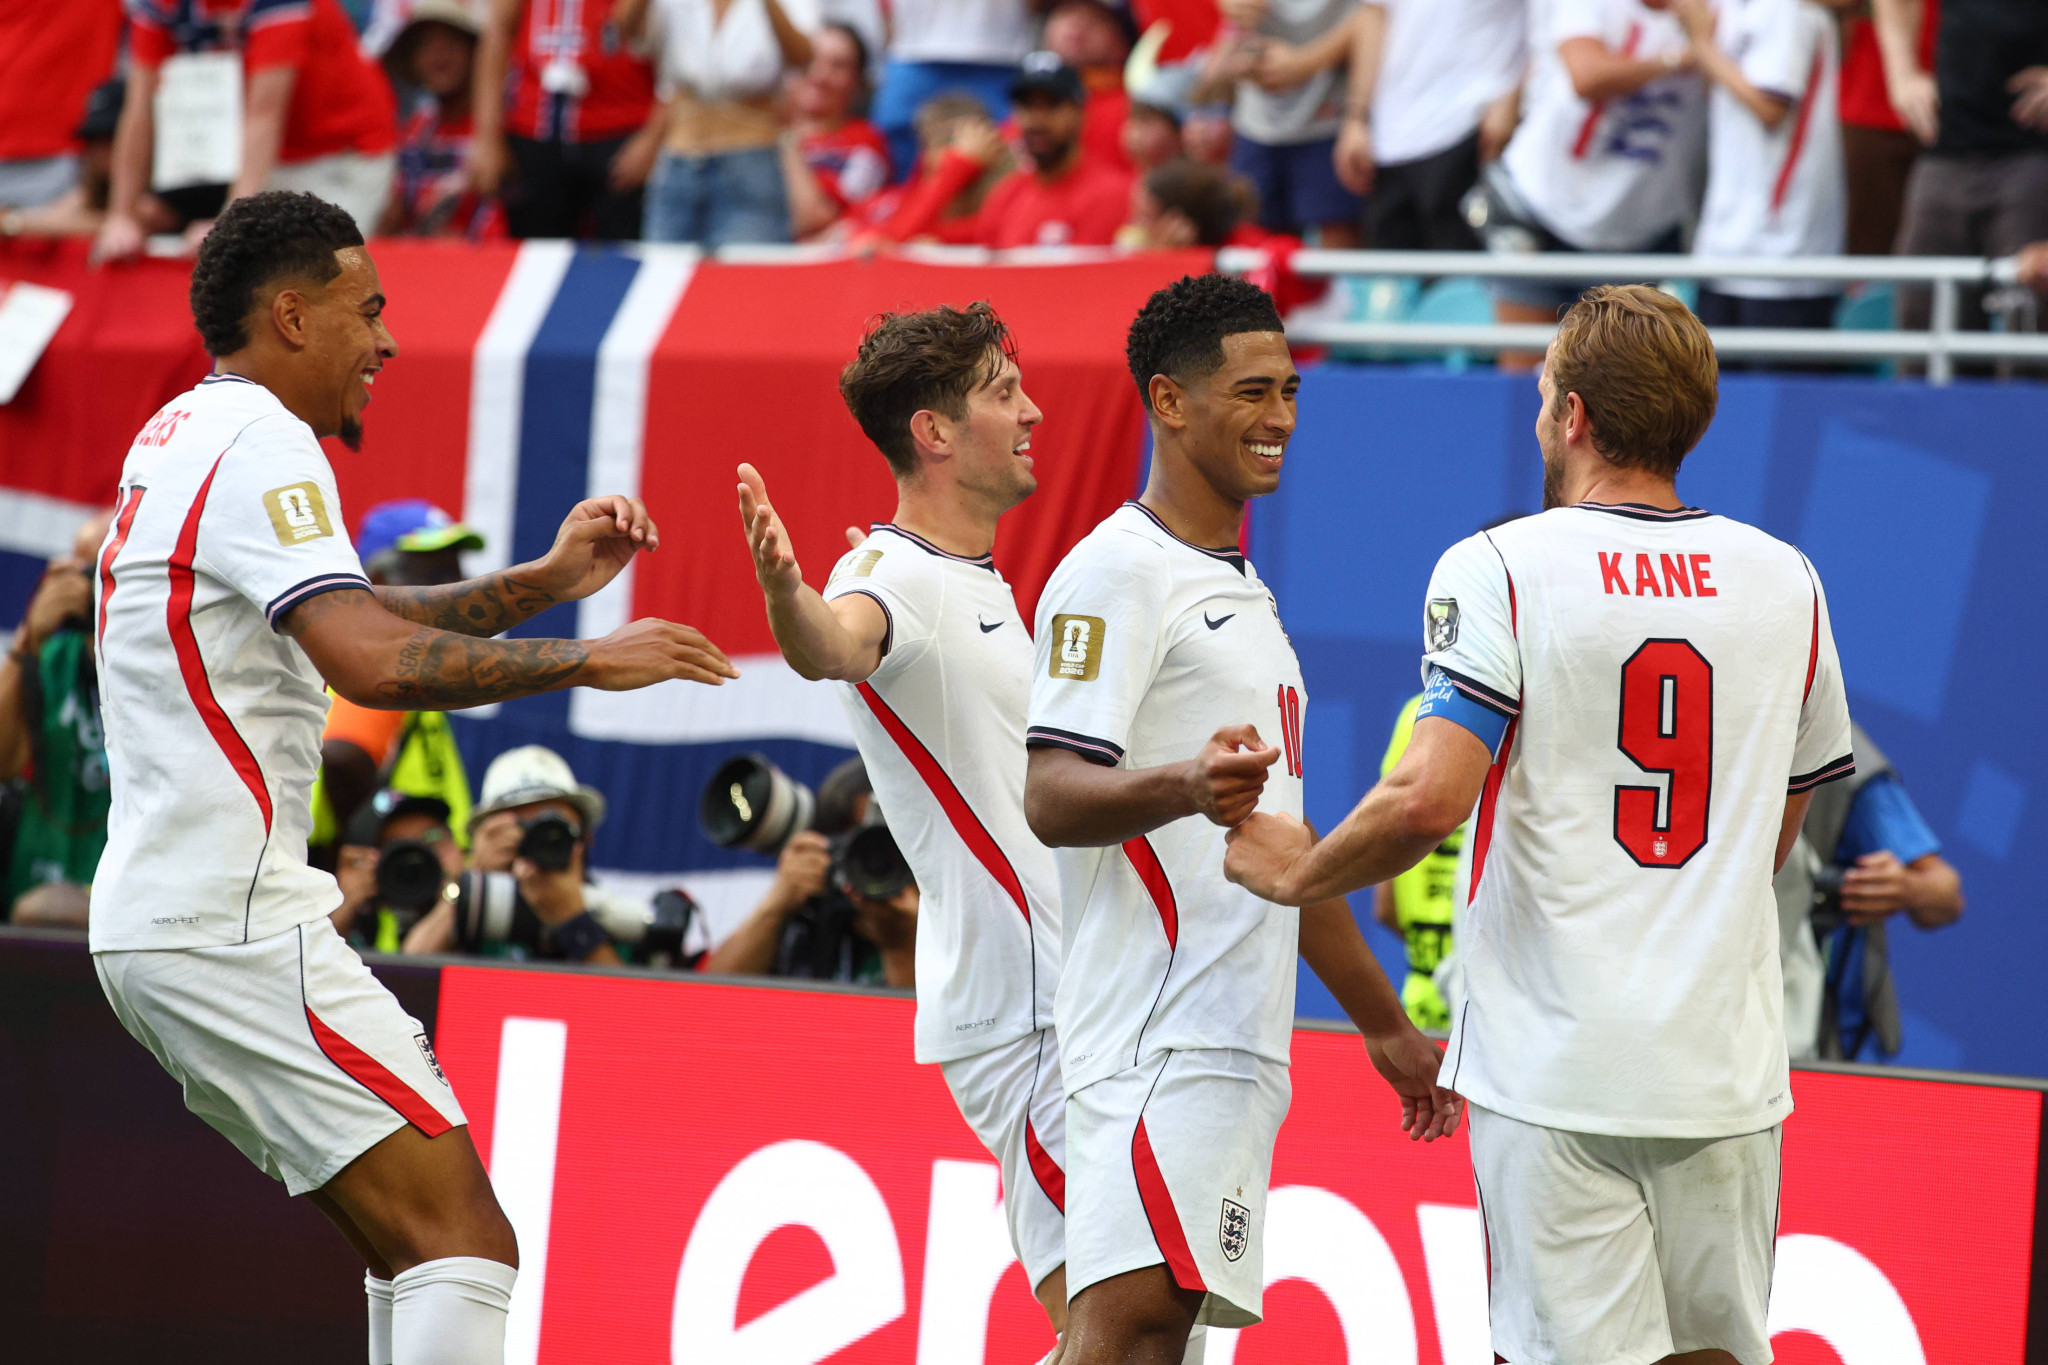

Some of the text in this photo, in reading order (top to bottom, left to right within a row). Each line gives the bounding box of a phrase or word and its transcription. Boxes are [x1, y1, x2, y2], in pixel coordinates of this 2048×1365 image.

[1598, 551, 1718, 598] KANE
[1059, 667, 1084, 676] 2026
[1277, 683, 1303, 779] 10
[1613, 637, 1714, 870] 9
[150, 916, 201, 925] AERO-FIT
[955, 1017, 998, 1032] AERO-FIT
